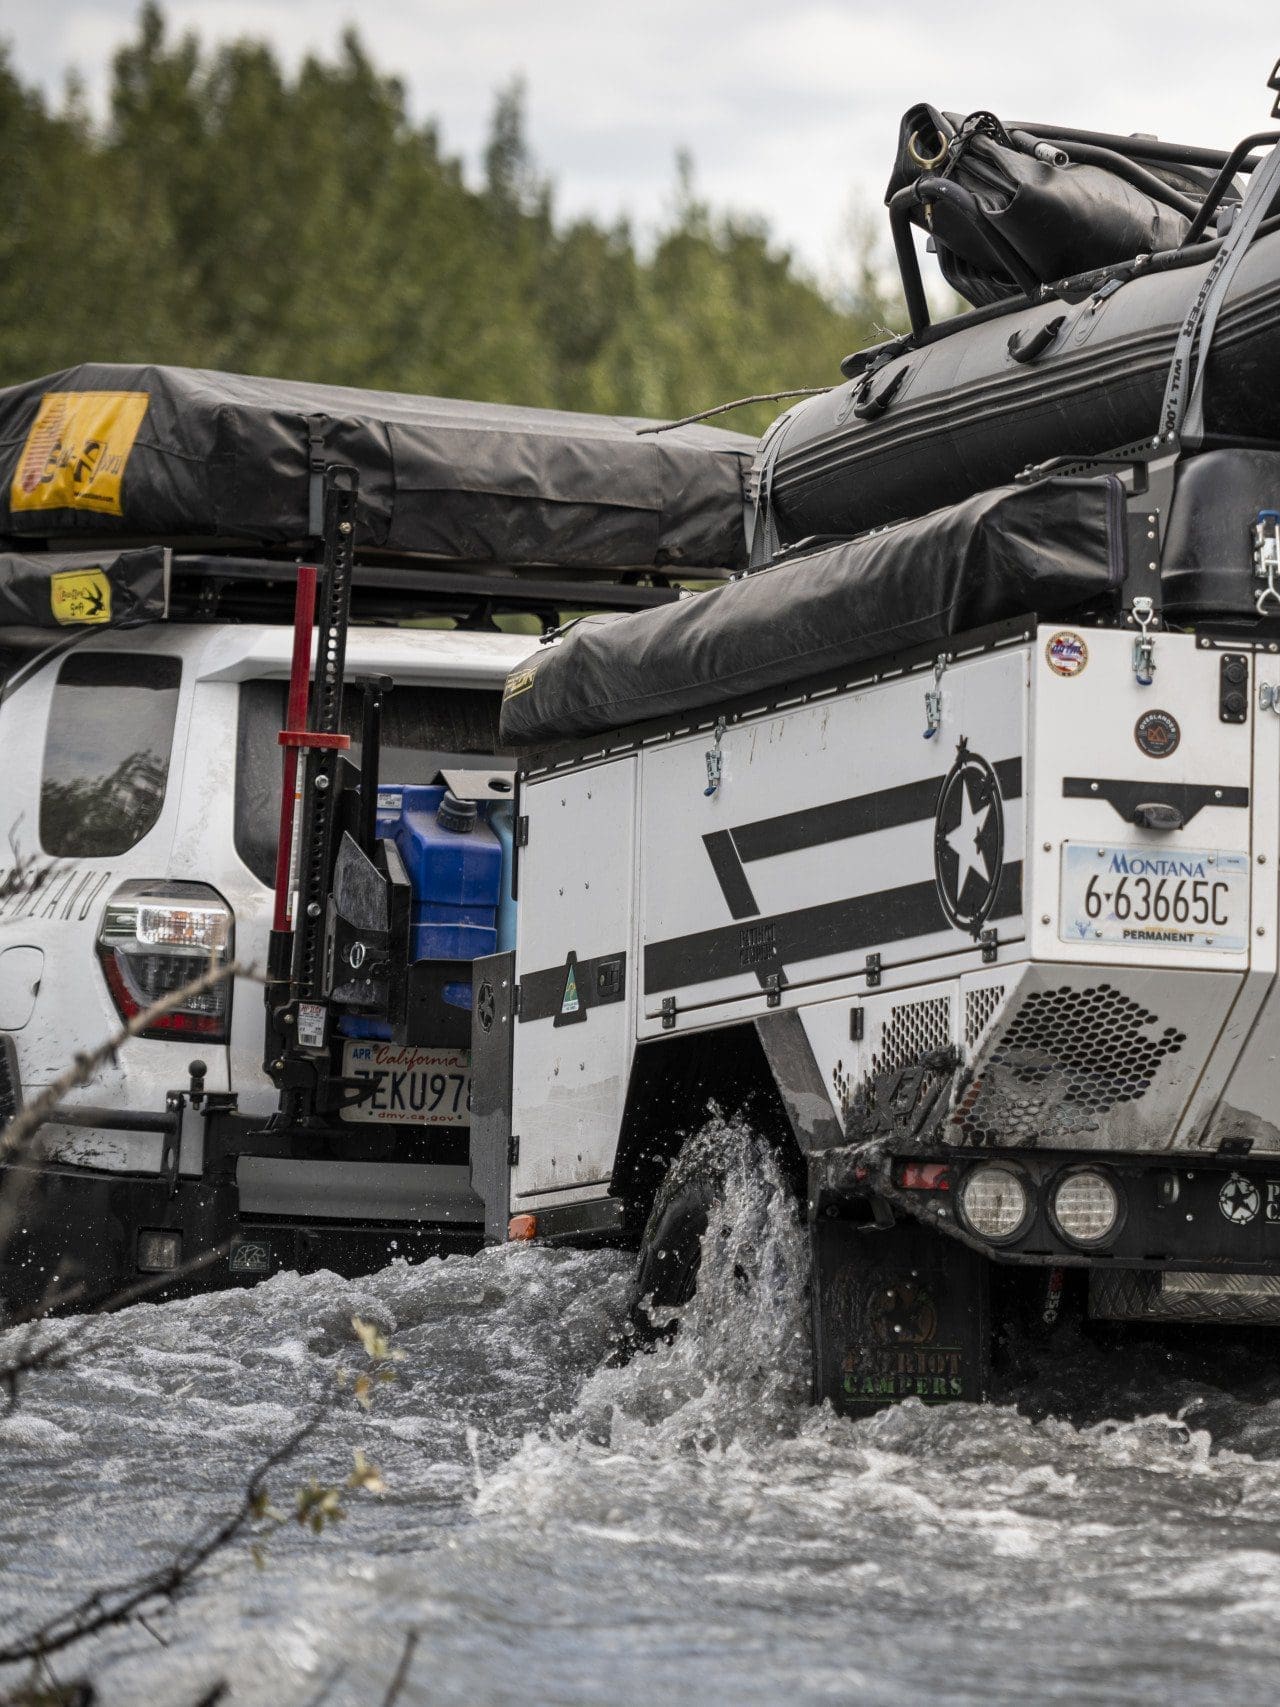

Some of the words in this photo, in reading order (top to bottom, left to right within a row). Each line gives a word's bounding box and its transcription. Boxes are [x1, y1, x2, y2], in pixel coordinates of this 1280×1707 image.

[1183, 249, 1229, 338] KEEPER
[1171, 358, 1183, 392] WLL
[1122, 929, 1195, 943] PERMANENT
[352, 1048, 371, 1060] APR
[375, 1045, 468, 1072] California
[378, 1111, 454, 1122] dmv.ca.gov
[843, 1375, 963, 1395] CAMPERS
